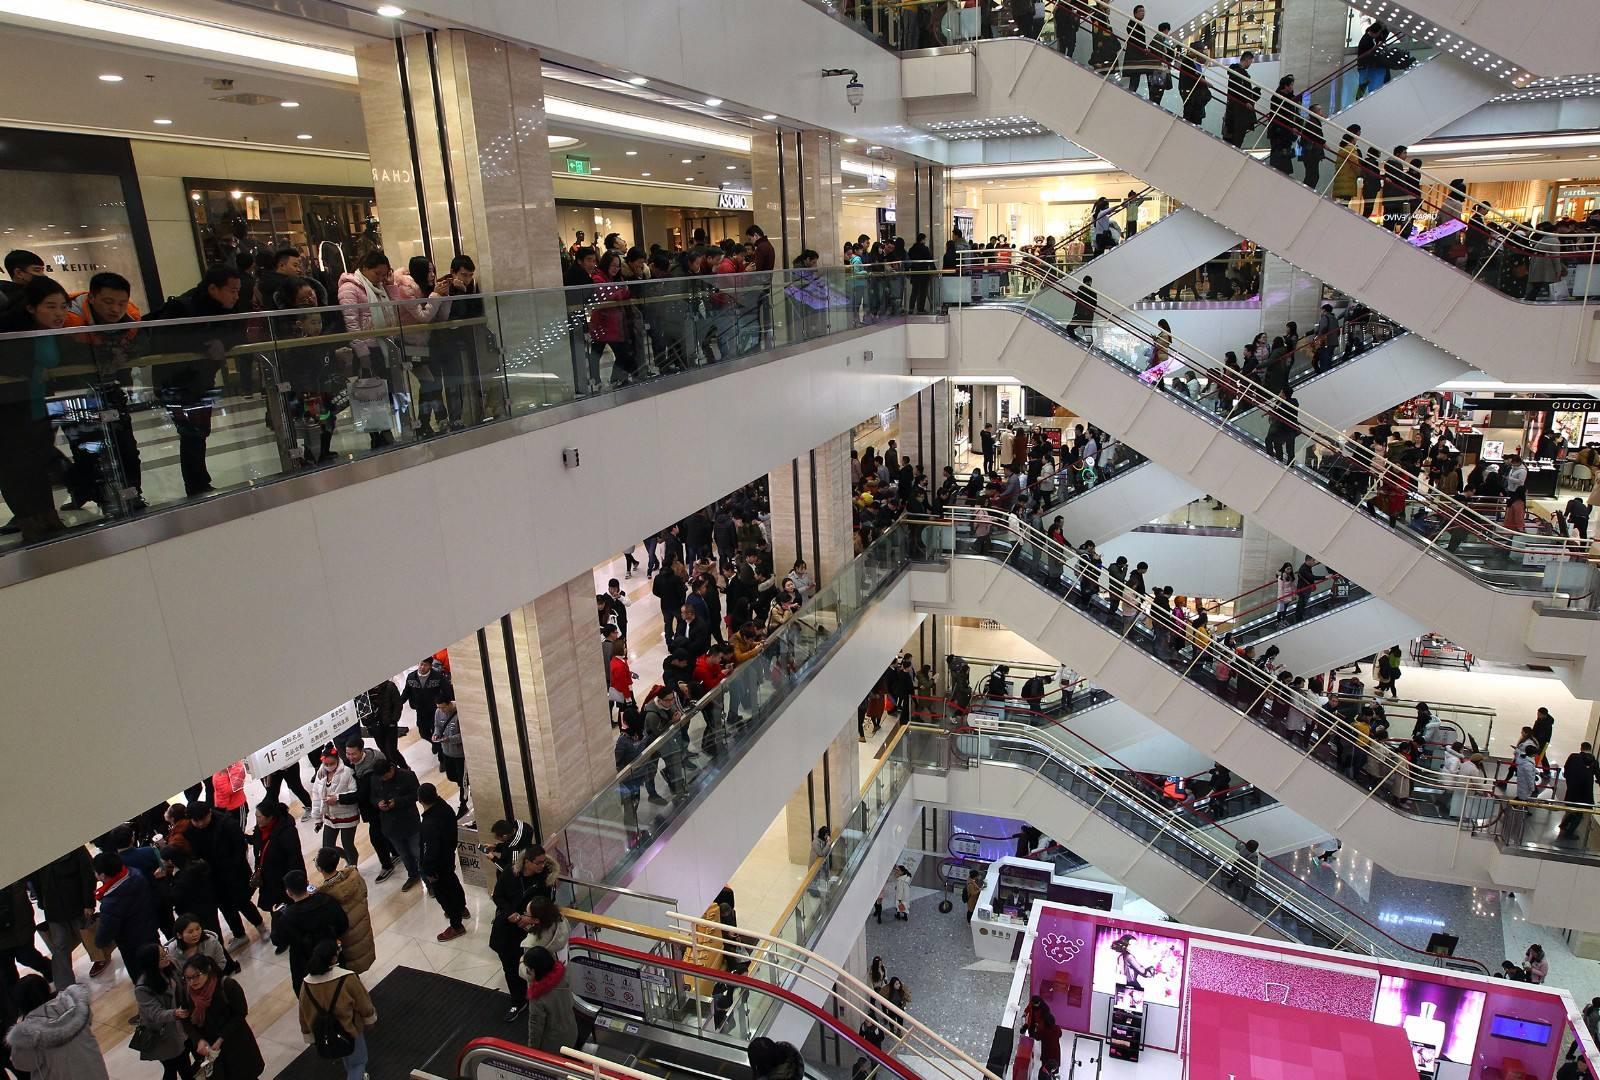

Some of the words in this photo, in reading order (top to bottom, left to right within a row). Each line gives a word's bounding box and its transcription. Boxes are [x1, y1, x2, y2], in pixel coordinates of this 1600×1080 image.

[46, 264, 54, 273] &
[62, 263, 98, 273] KEITH
[1552, 401, 1597, 410] GUCCI
[263, 748, 279, 764] 1F
